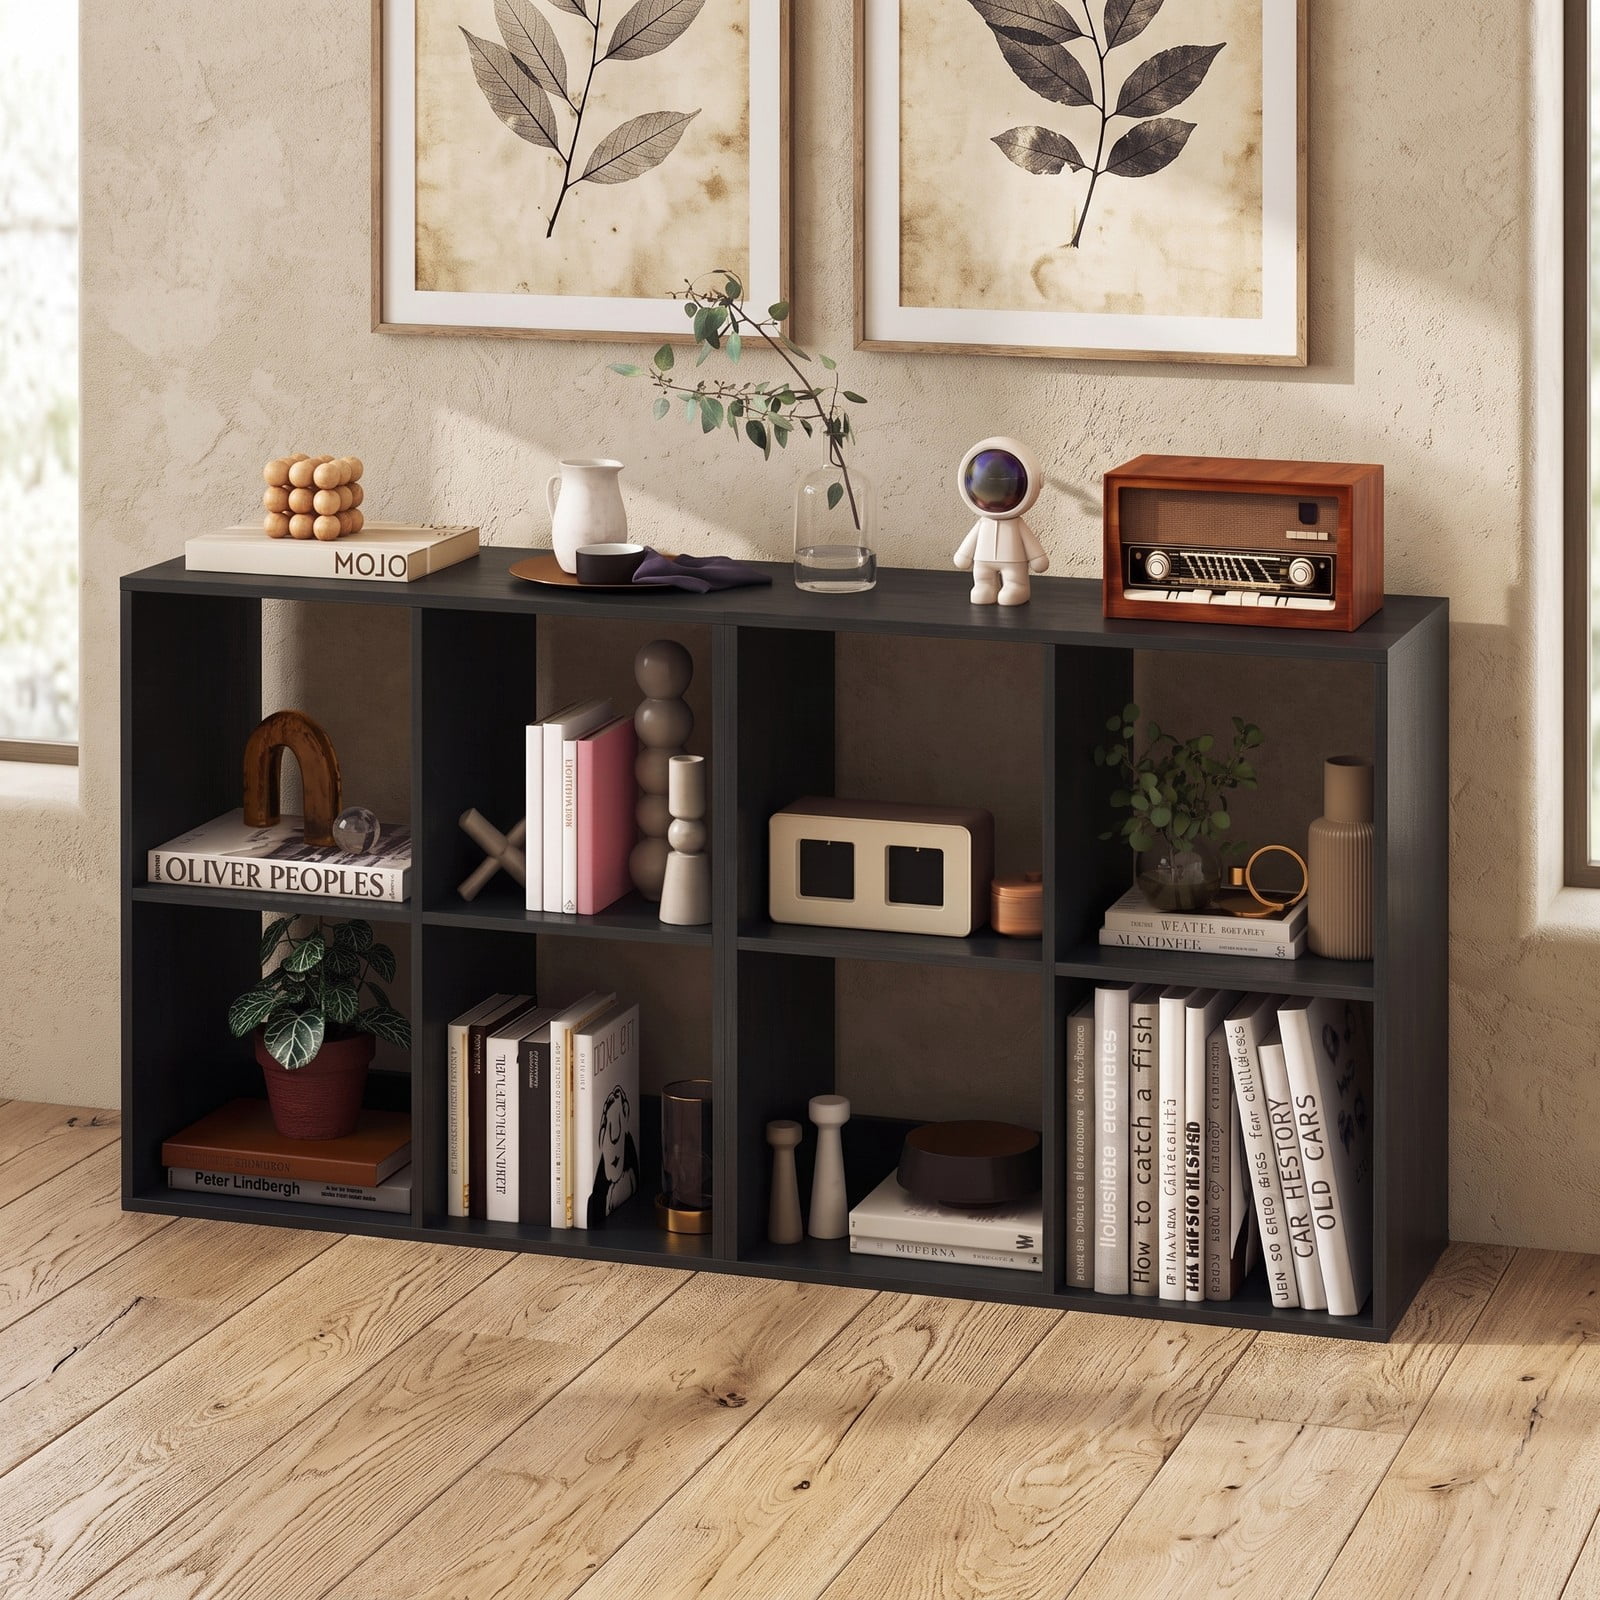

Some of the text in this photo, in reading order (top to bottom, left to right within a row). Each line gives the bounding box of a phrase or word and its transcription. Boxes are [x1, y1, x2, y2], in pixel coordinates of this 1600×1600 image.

[166, 857, 262, 888] OLIVER
[269, 865, 385, 898] PEOPLES
[195, 1171, 230, 1188] Peter
[233, 1175, 300, 1197] Lindbergh
[1131, 1016, 1152, 1283] How to catch a fish
[1268, 1098, 1314, 1258] CAR HESTORY
[1296, 1095, 1336, 1230] OLD CARS
